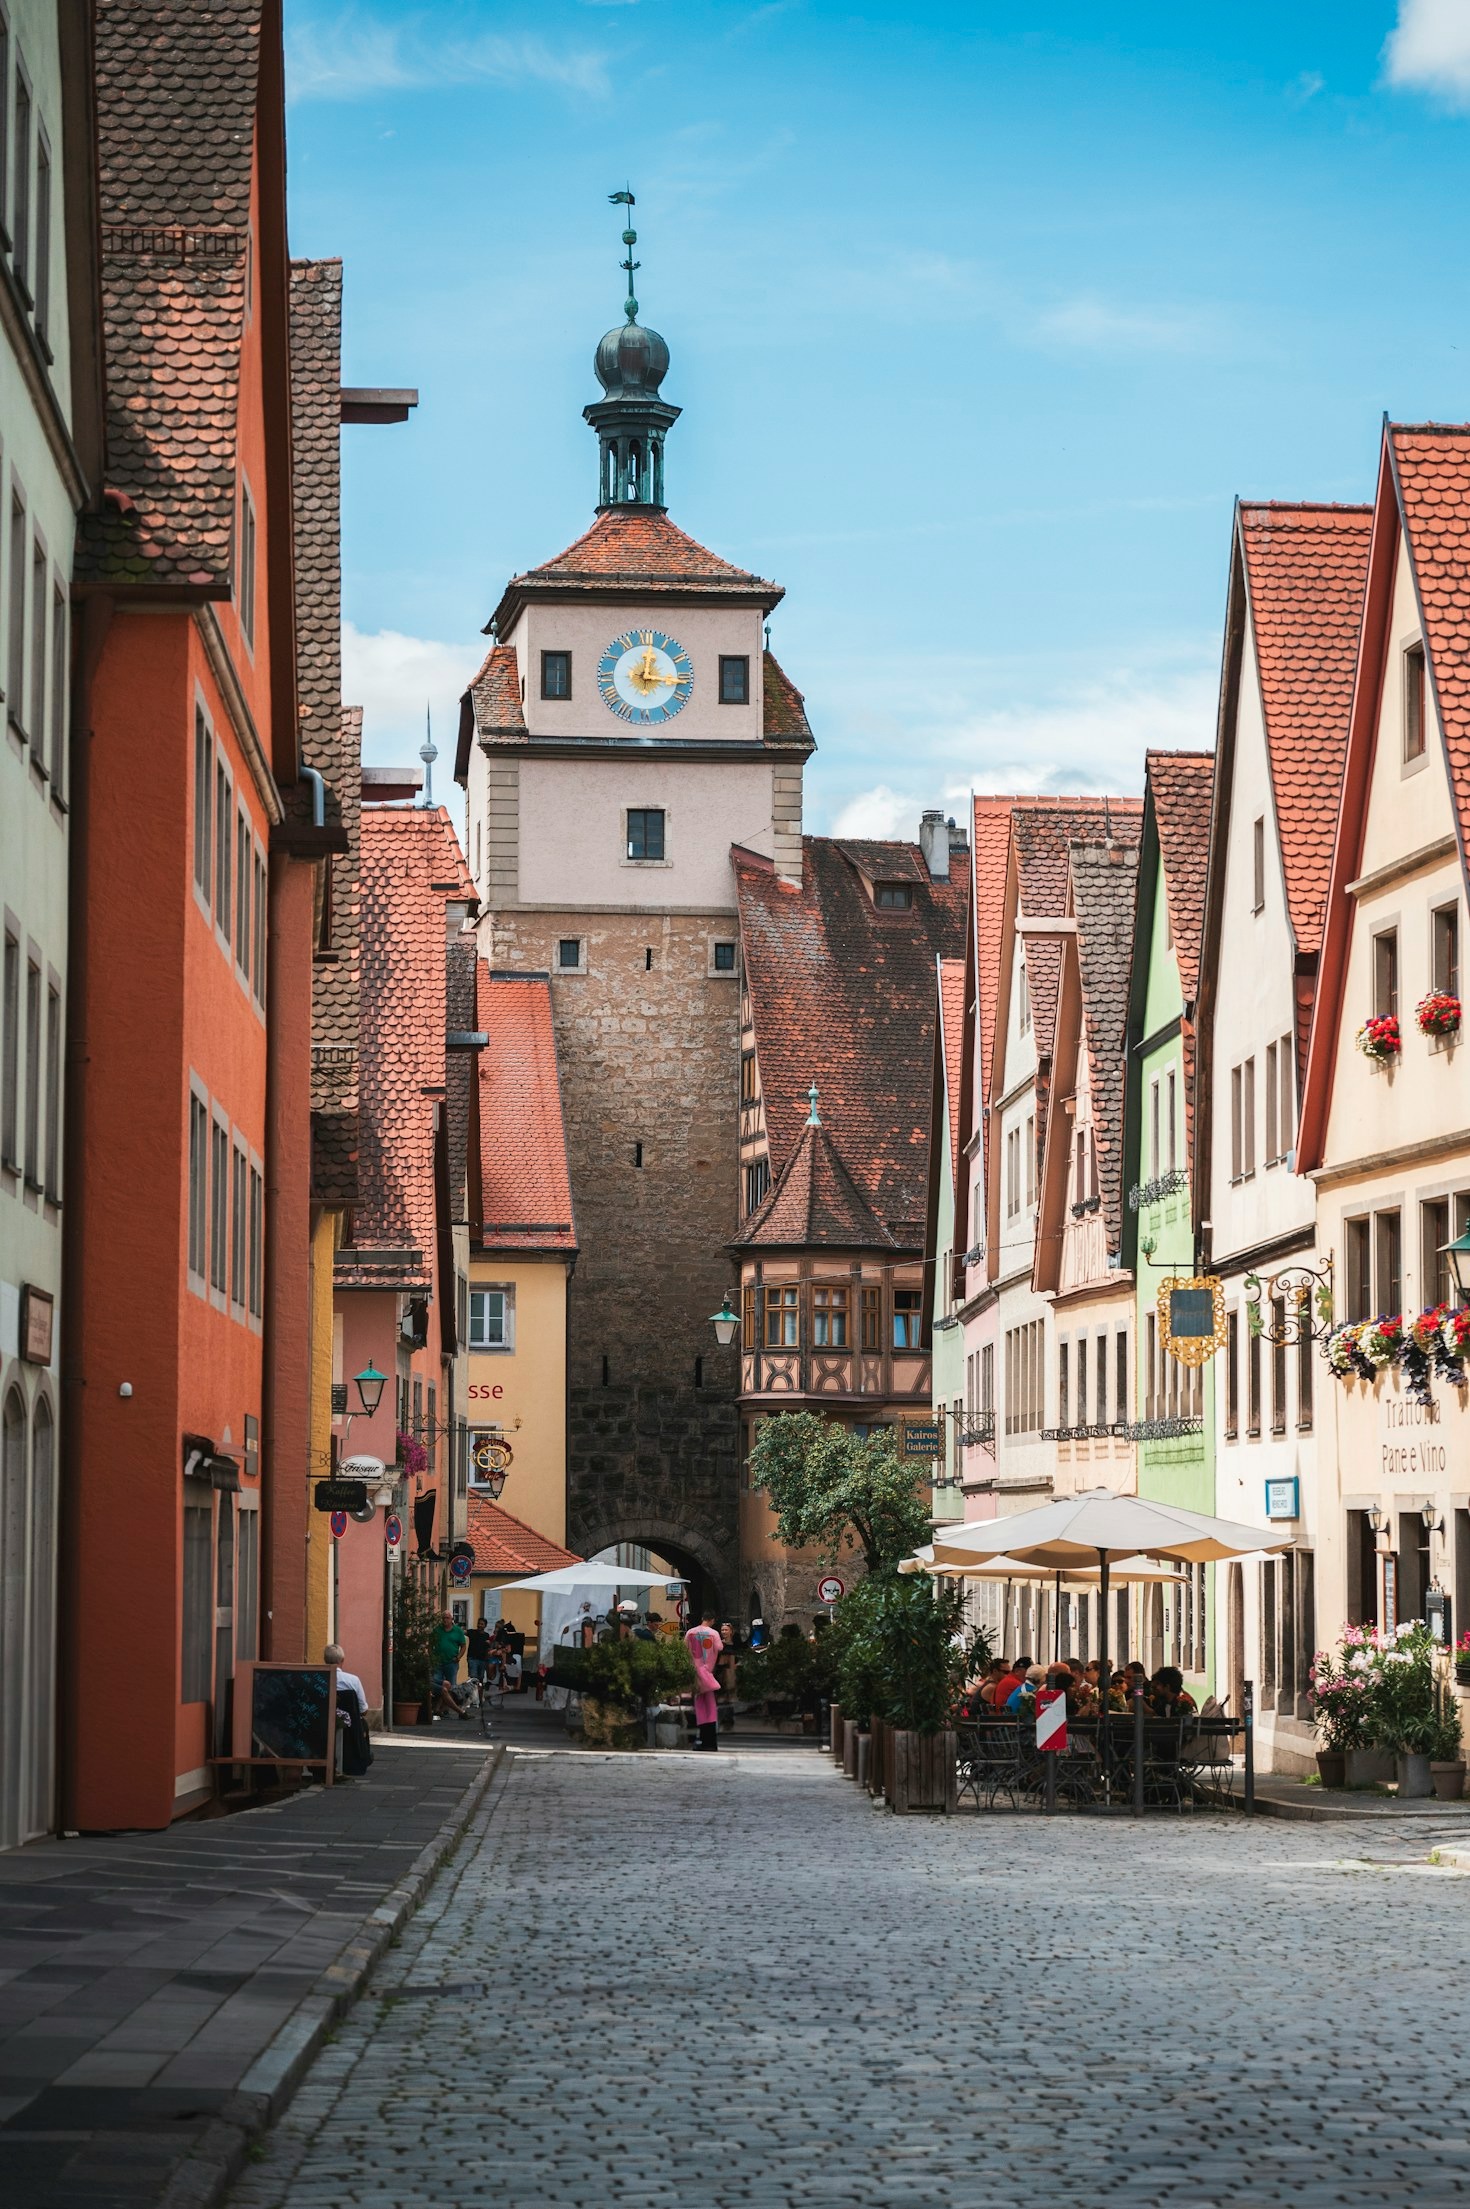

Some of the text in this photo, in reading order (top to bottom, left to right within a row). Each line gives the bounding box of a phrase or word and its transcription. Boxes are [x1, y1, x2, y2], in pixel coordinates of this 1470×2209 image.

[906, 1430, 938, 1439] Kairos
[906, 1442, 938, 1451] Galerie
[1382, 1440, 1446, 1473] Pane e Vino
[345, 1463, 380, 1473] Friseur
